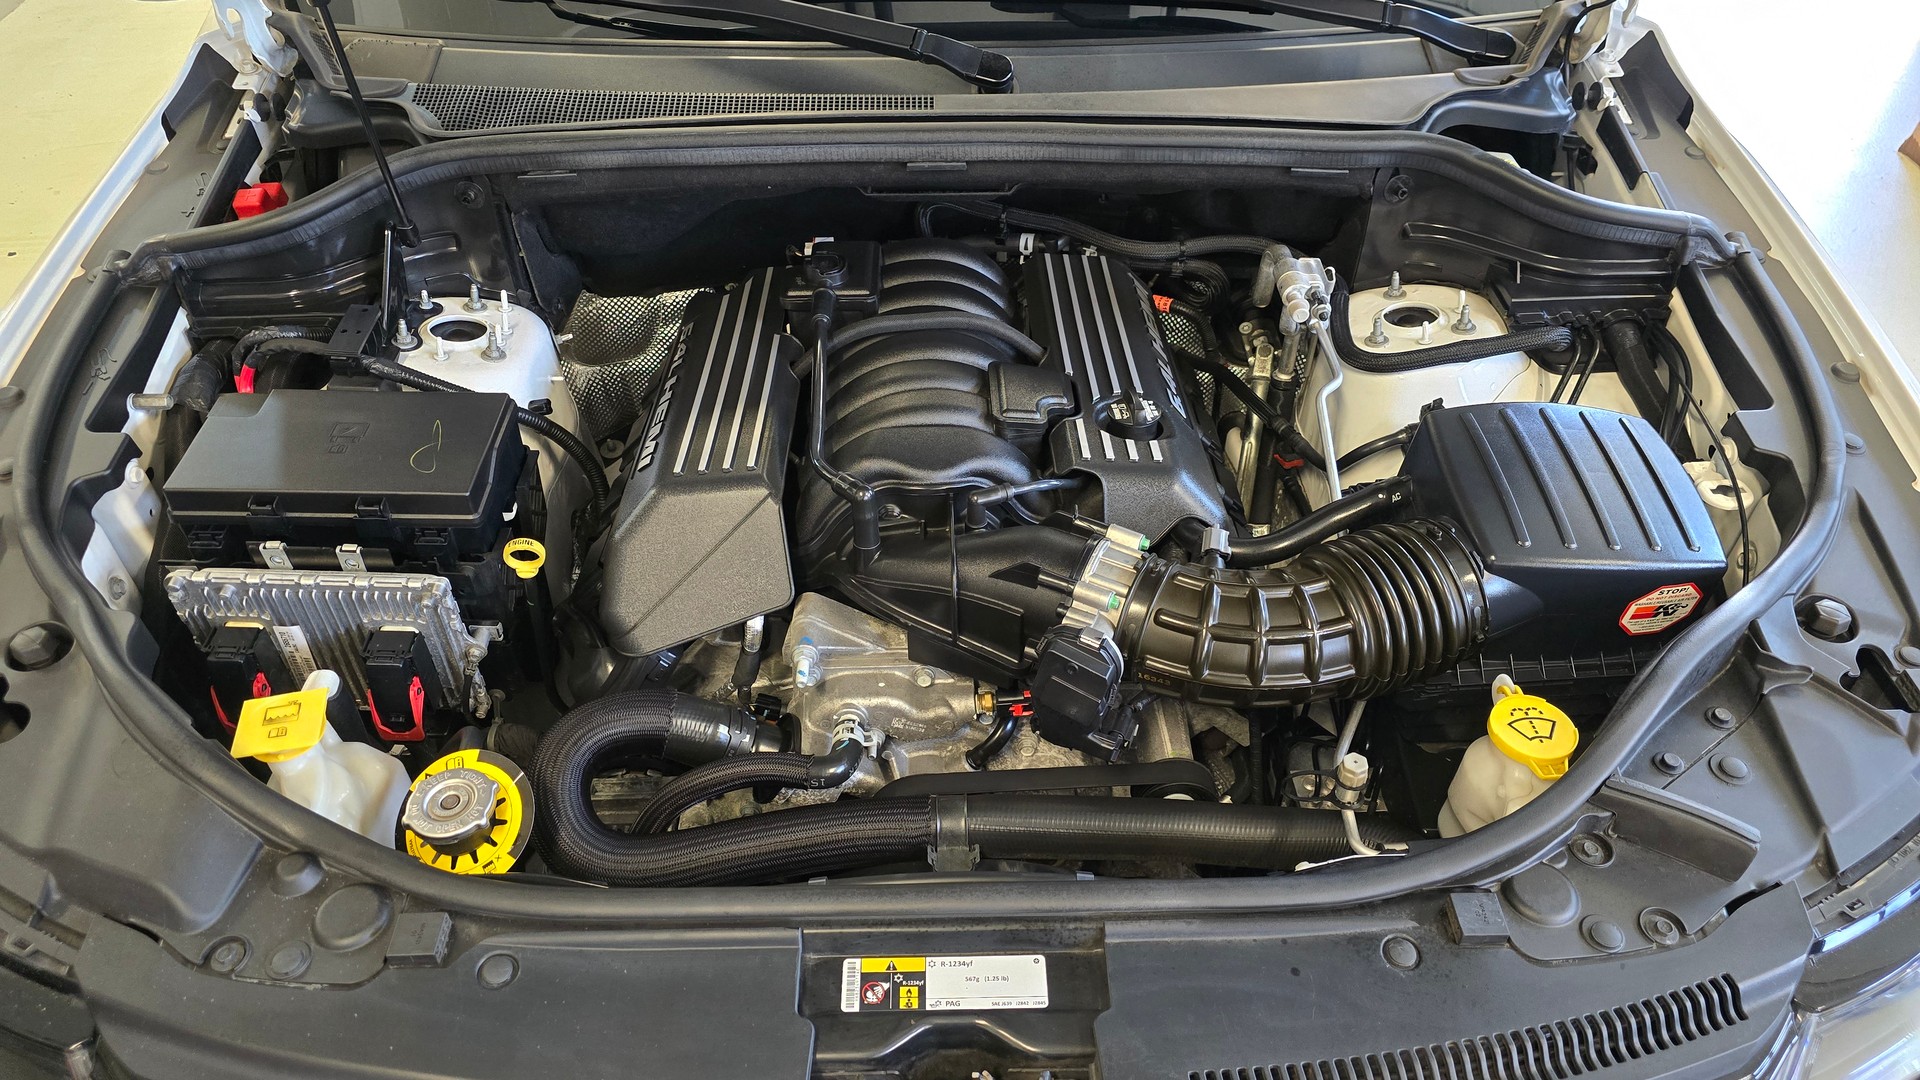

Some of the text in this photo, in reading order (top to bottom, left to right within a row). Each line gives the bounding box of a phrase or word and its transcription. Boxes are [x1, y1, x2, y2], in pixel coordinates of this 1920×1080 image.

[1128, 272, 1168, 363] HEMI
[637, 375, 678, 472] HEMI
[1392, 492, 1402, 503] AC
[1658, 587, 1690, 596] STOP!
[423, 771, 453, 788] KEEP
[436, 821, 464, 833] OPEN
[464, 806, 484, 823] HOT
[940, 960, 974, 968] R-1234yf
[984, 975, 1000, 983] (1.25
[1000, 975, 1010, 983] lb)
